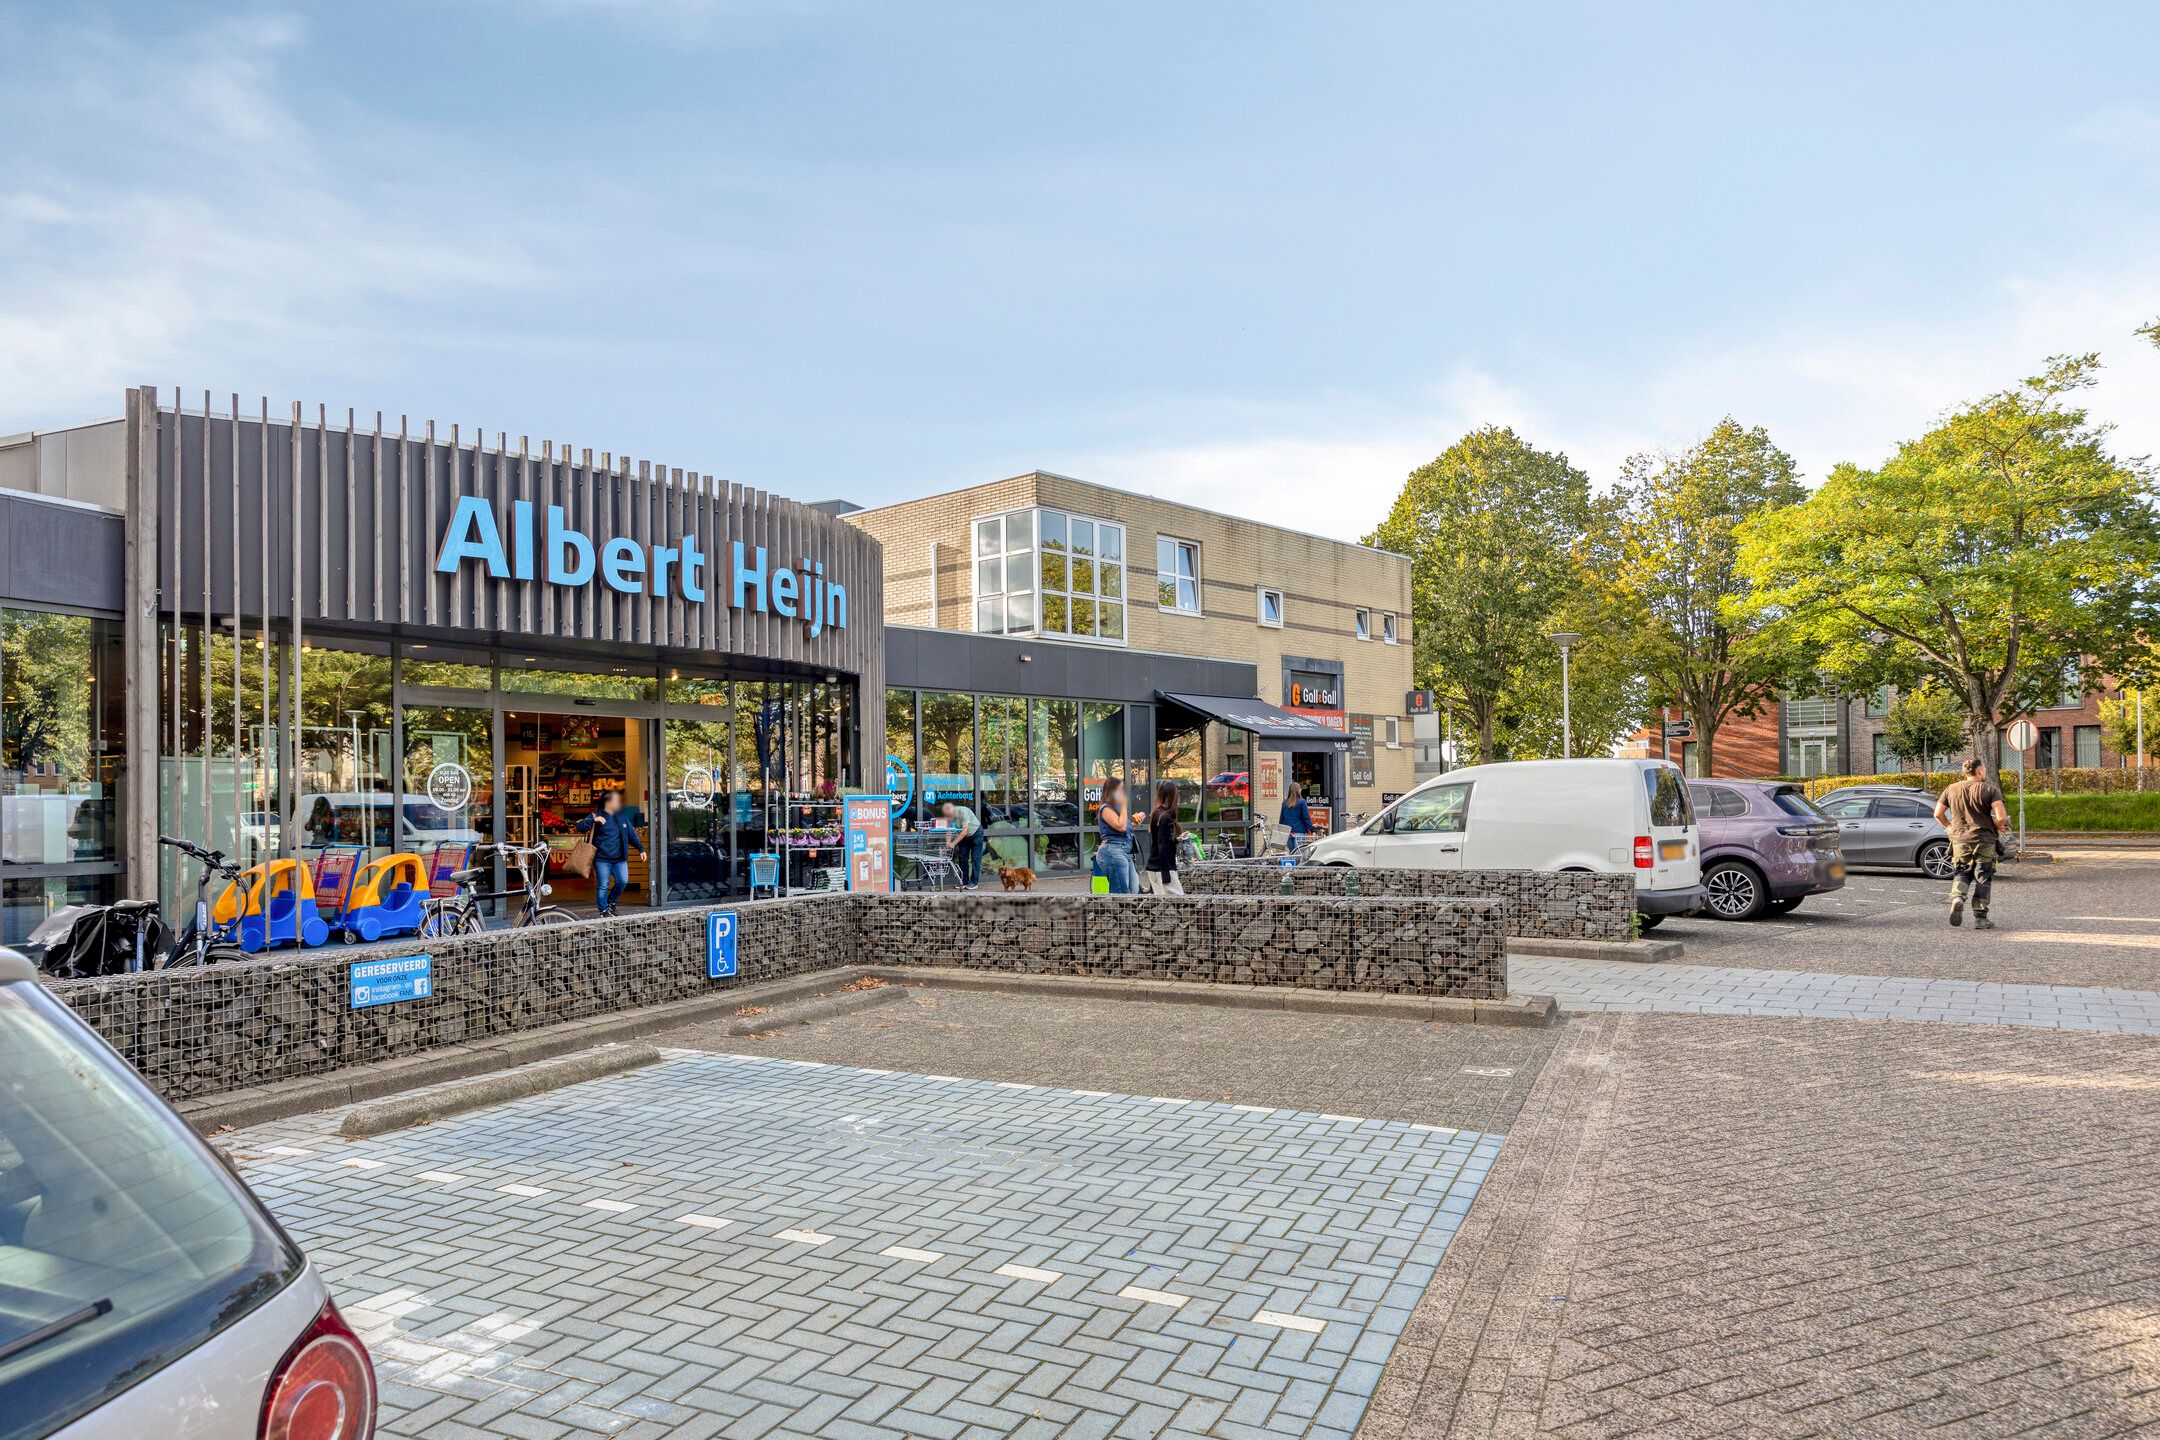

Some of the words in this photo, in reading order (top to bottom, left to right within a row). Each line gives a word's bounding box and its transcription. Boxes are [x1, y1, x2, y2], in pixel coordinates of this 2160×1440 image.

[436, 496, 704, 602] Albert
[727, 541, 846, 638] Heijn
[438, 776, 460, 784] OPEN
[857, 808, 887, 820] BONUS
[716, 918, 730, 949] P
[354, 959, 427, 978] GERESERVEERD
[376, 976, 392, 984] VOOR
[393, 974, 408, 982] ONZE
